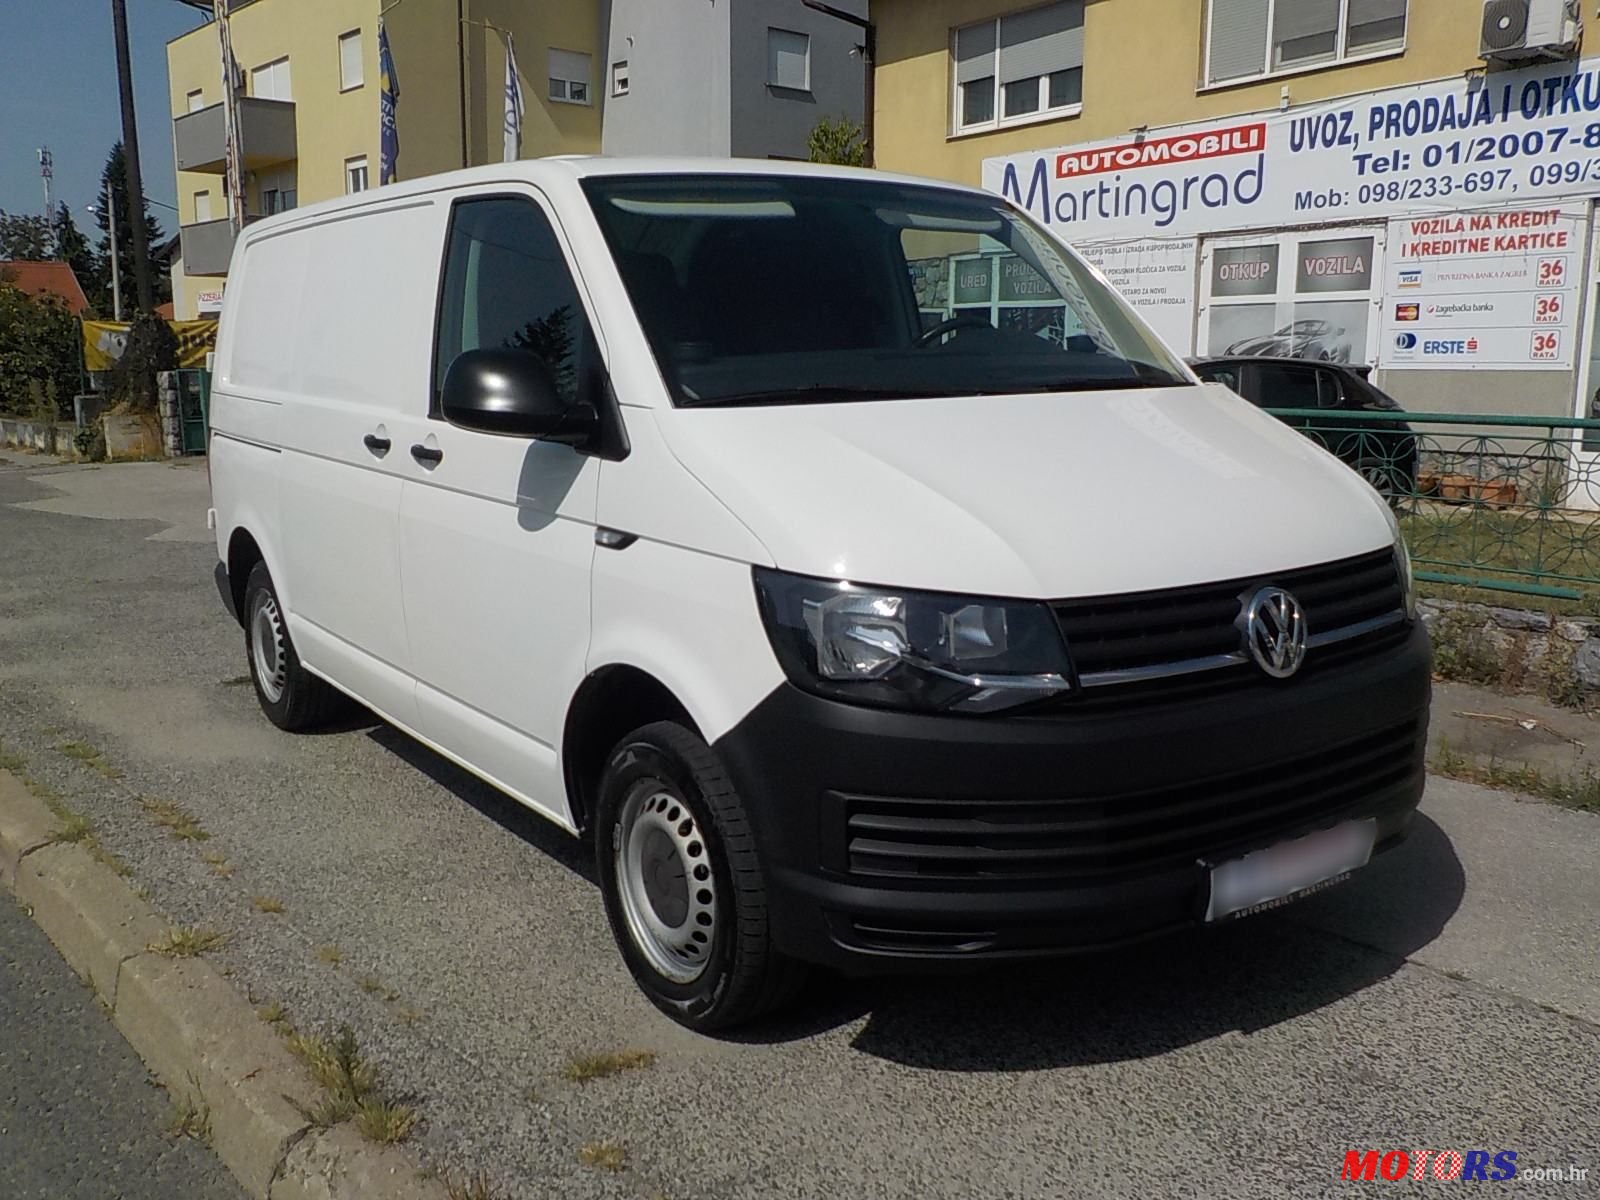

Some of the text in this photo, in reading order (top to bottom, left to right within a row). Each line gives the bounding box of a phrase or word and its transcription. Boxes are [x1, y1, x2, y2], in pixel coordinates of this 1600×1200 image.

[1289, 110, 1359, 152] UVOZ,
[1368, 88, 1491, 142] PRODAJA
[1501, 84, 1512, 122] I
[1062, 129, 1258, 174] AUTOMOBILI
[1352, 122, 1600, 176] Tel: 01/2007-8
[1002, 153, 1264, 227] Martingrad
[1294, 188, 1349, 210] Mob:
[1358, 169, 1518, 204] 098/233-697,
[1411, 209, 1561, 236] VOZILA NA KREDIT
[1401, 232, 1568, 257] I KREDITNE KARTICE
[1219, 262, 1271, 281] OTKUP
[1304, 256, 1365, 276] VOZILA
[1540, 259, 1563, 279] 36
[960, 274, 987, 289] URED
[1473, 302, 1494, 312] banka
[1537, 296, 1560, 316] 36
[1423, 340, 1465, 354] ERSTE
[1534, 333, 1557, 351] 36
